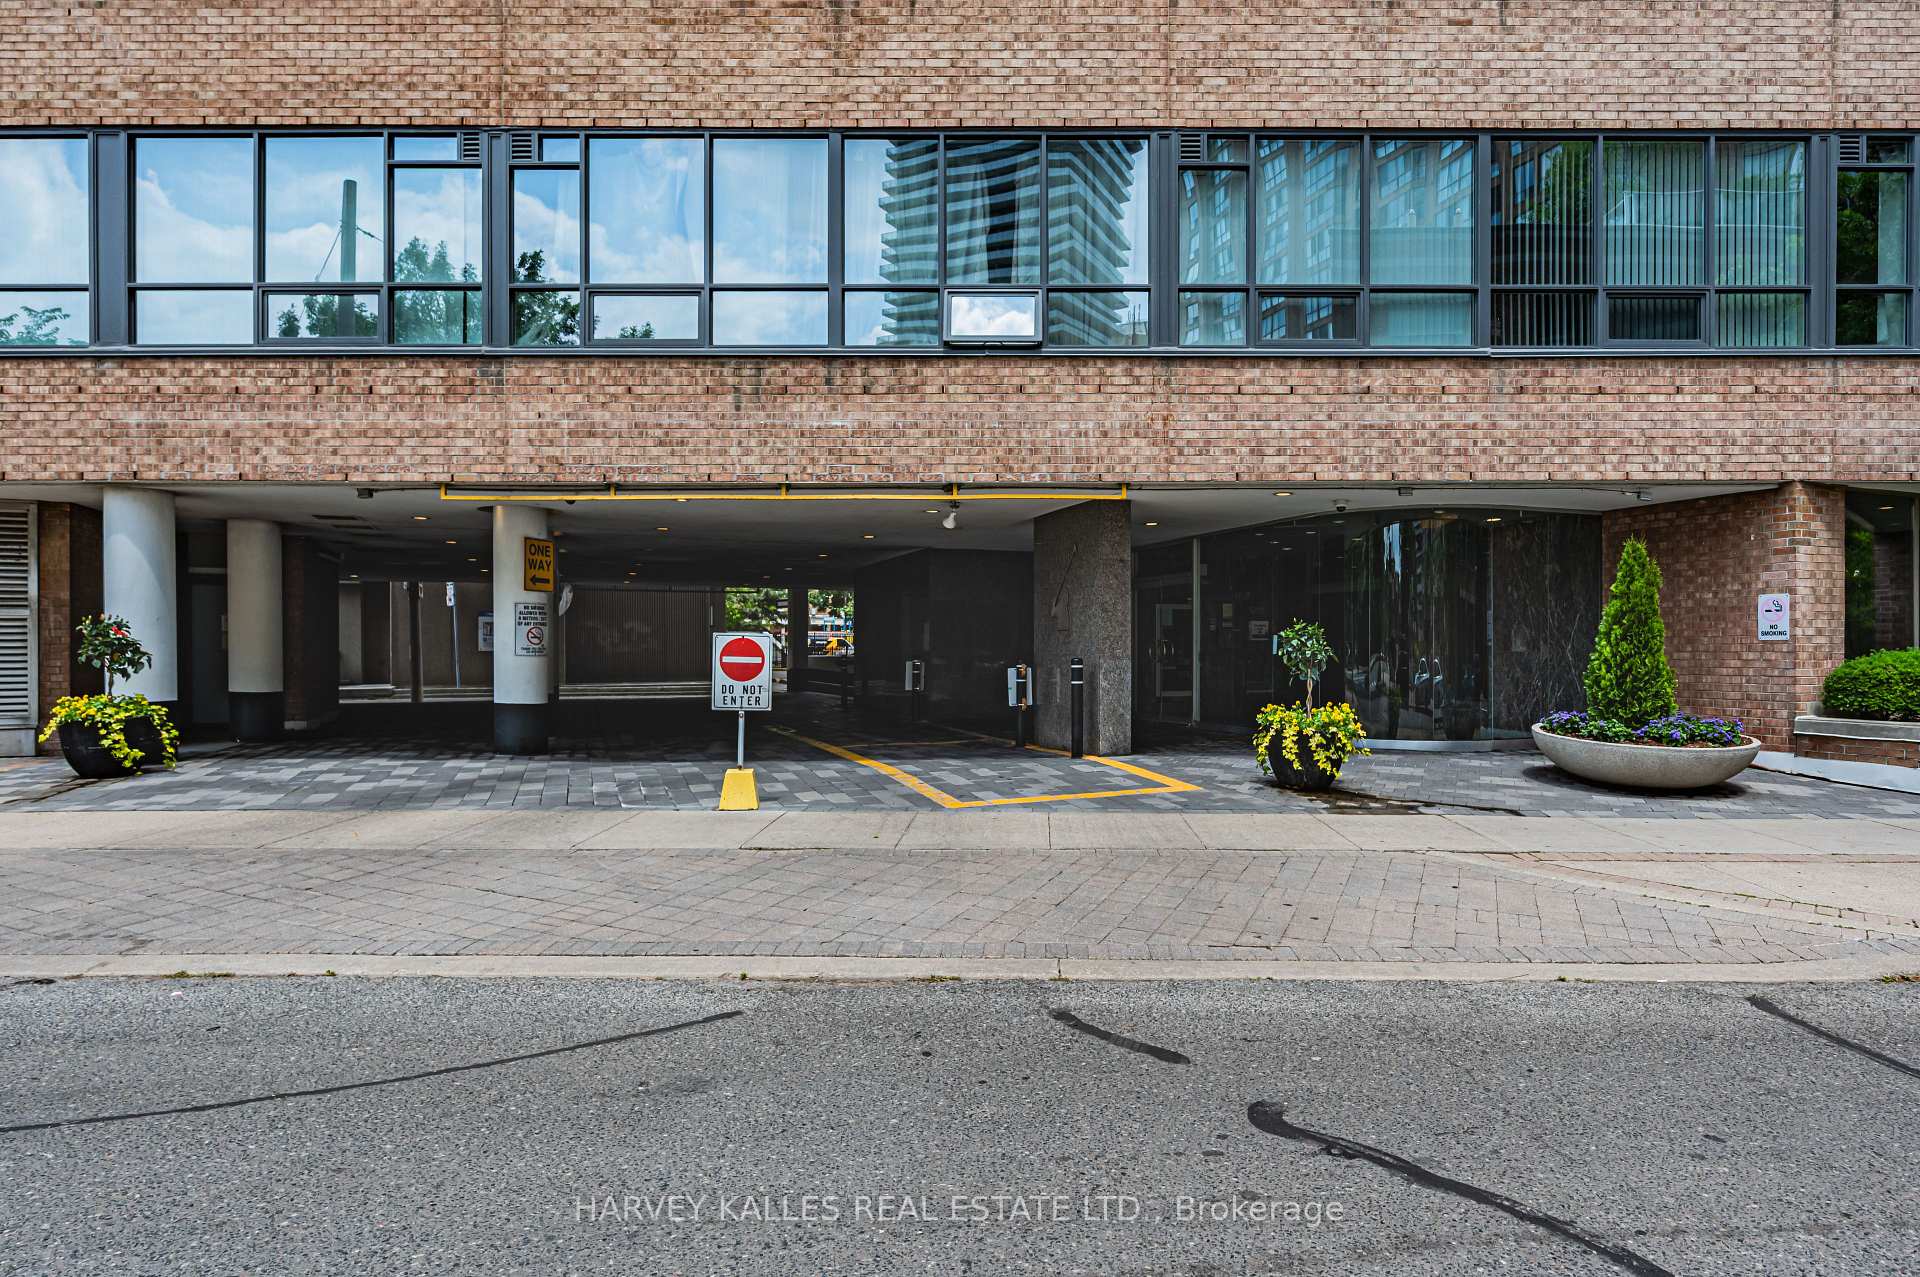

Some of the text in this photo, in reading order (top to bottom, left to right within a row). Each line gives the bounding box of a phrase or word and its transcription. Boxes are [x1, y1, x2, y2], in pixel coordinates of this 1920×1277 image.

[529, 544, 551, 557] ONE
[528, 559, 551, 571] WAY
[721, 684, 763, 695] DO NOT
[723, 696, 761, 706] ENTER
